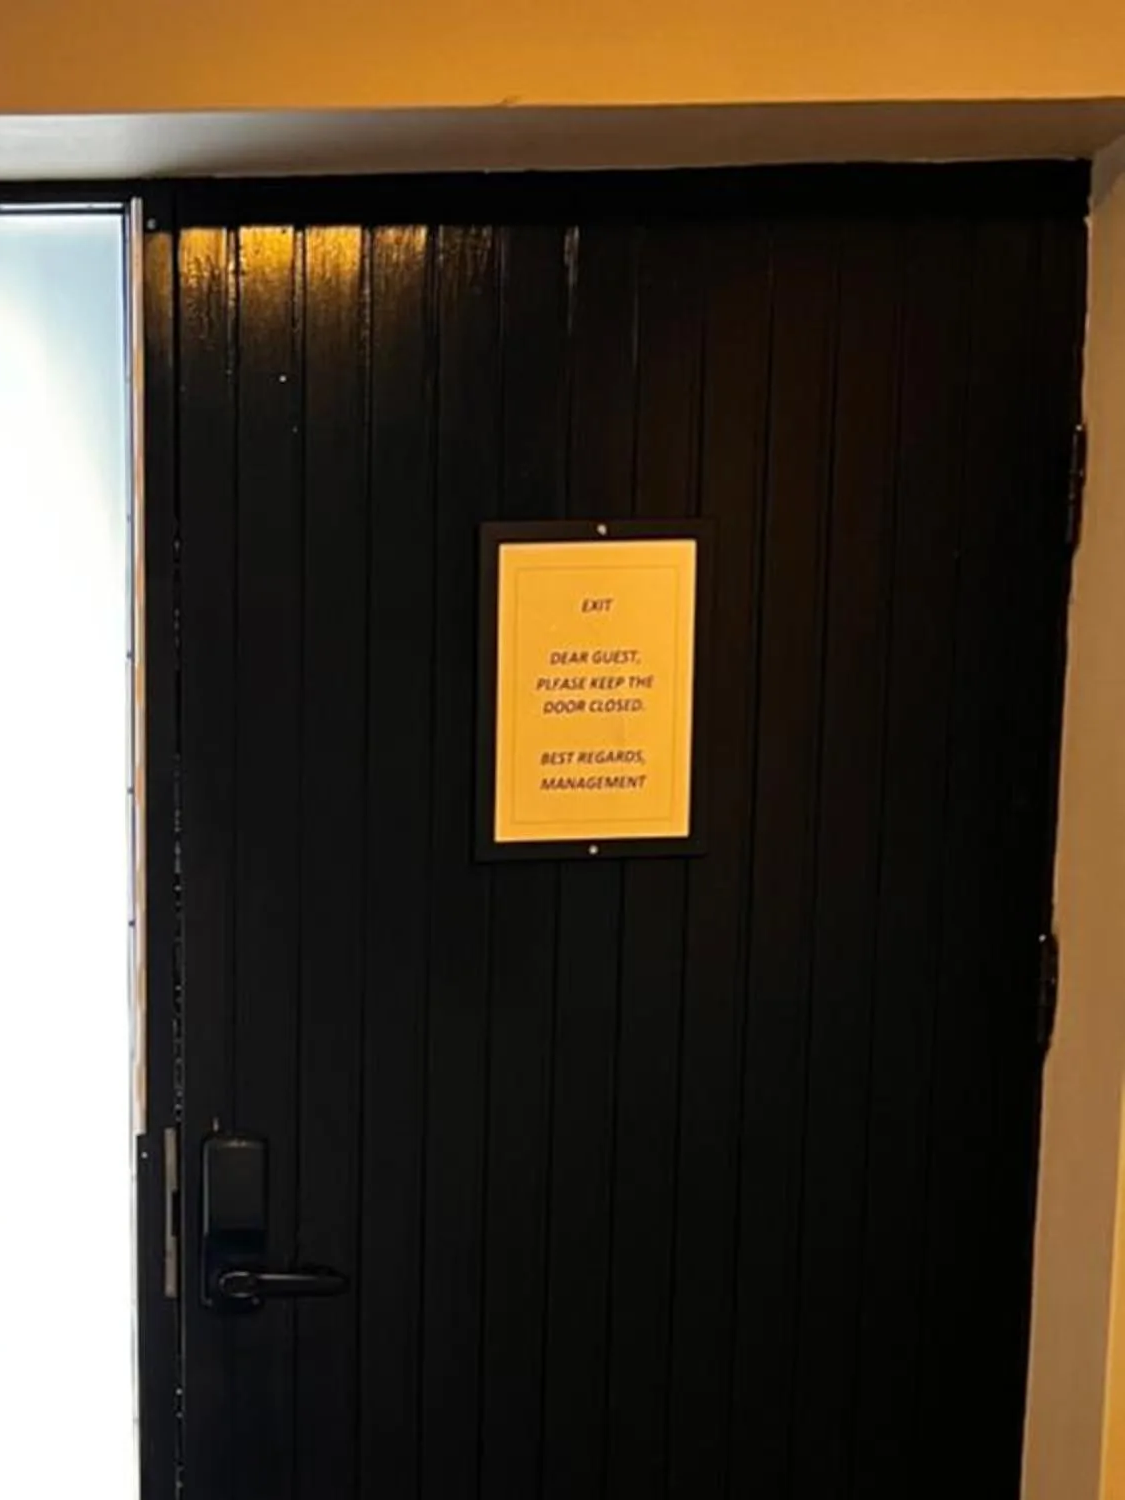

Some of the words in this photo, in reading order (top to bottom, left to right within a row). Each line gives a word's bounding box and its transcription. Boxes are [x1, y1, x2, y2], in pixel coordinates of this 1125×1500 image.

[581, 598, 613, 613] EXIT
[550, 651, 589, 665] DEAR
[592, 650, 641, 665] GUEST,
[536, 677, 586, 691] PLEASE
[589, 676, 625, 690] KEEP
[629, 674, 654, 689] THE
[543, 699, 586, 715] DOOR
[589, 698, 644, 713] CLOSED.
[540, 751, 575, 766] BEST
[577, 750, 646, 766] REGARDS,
[540, 774, 647, 791] MANAGEMENT
